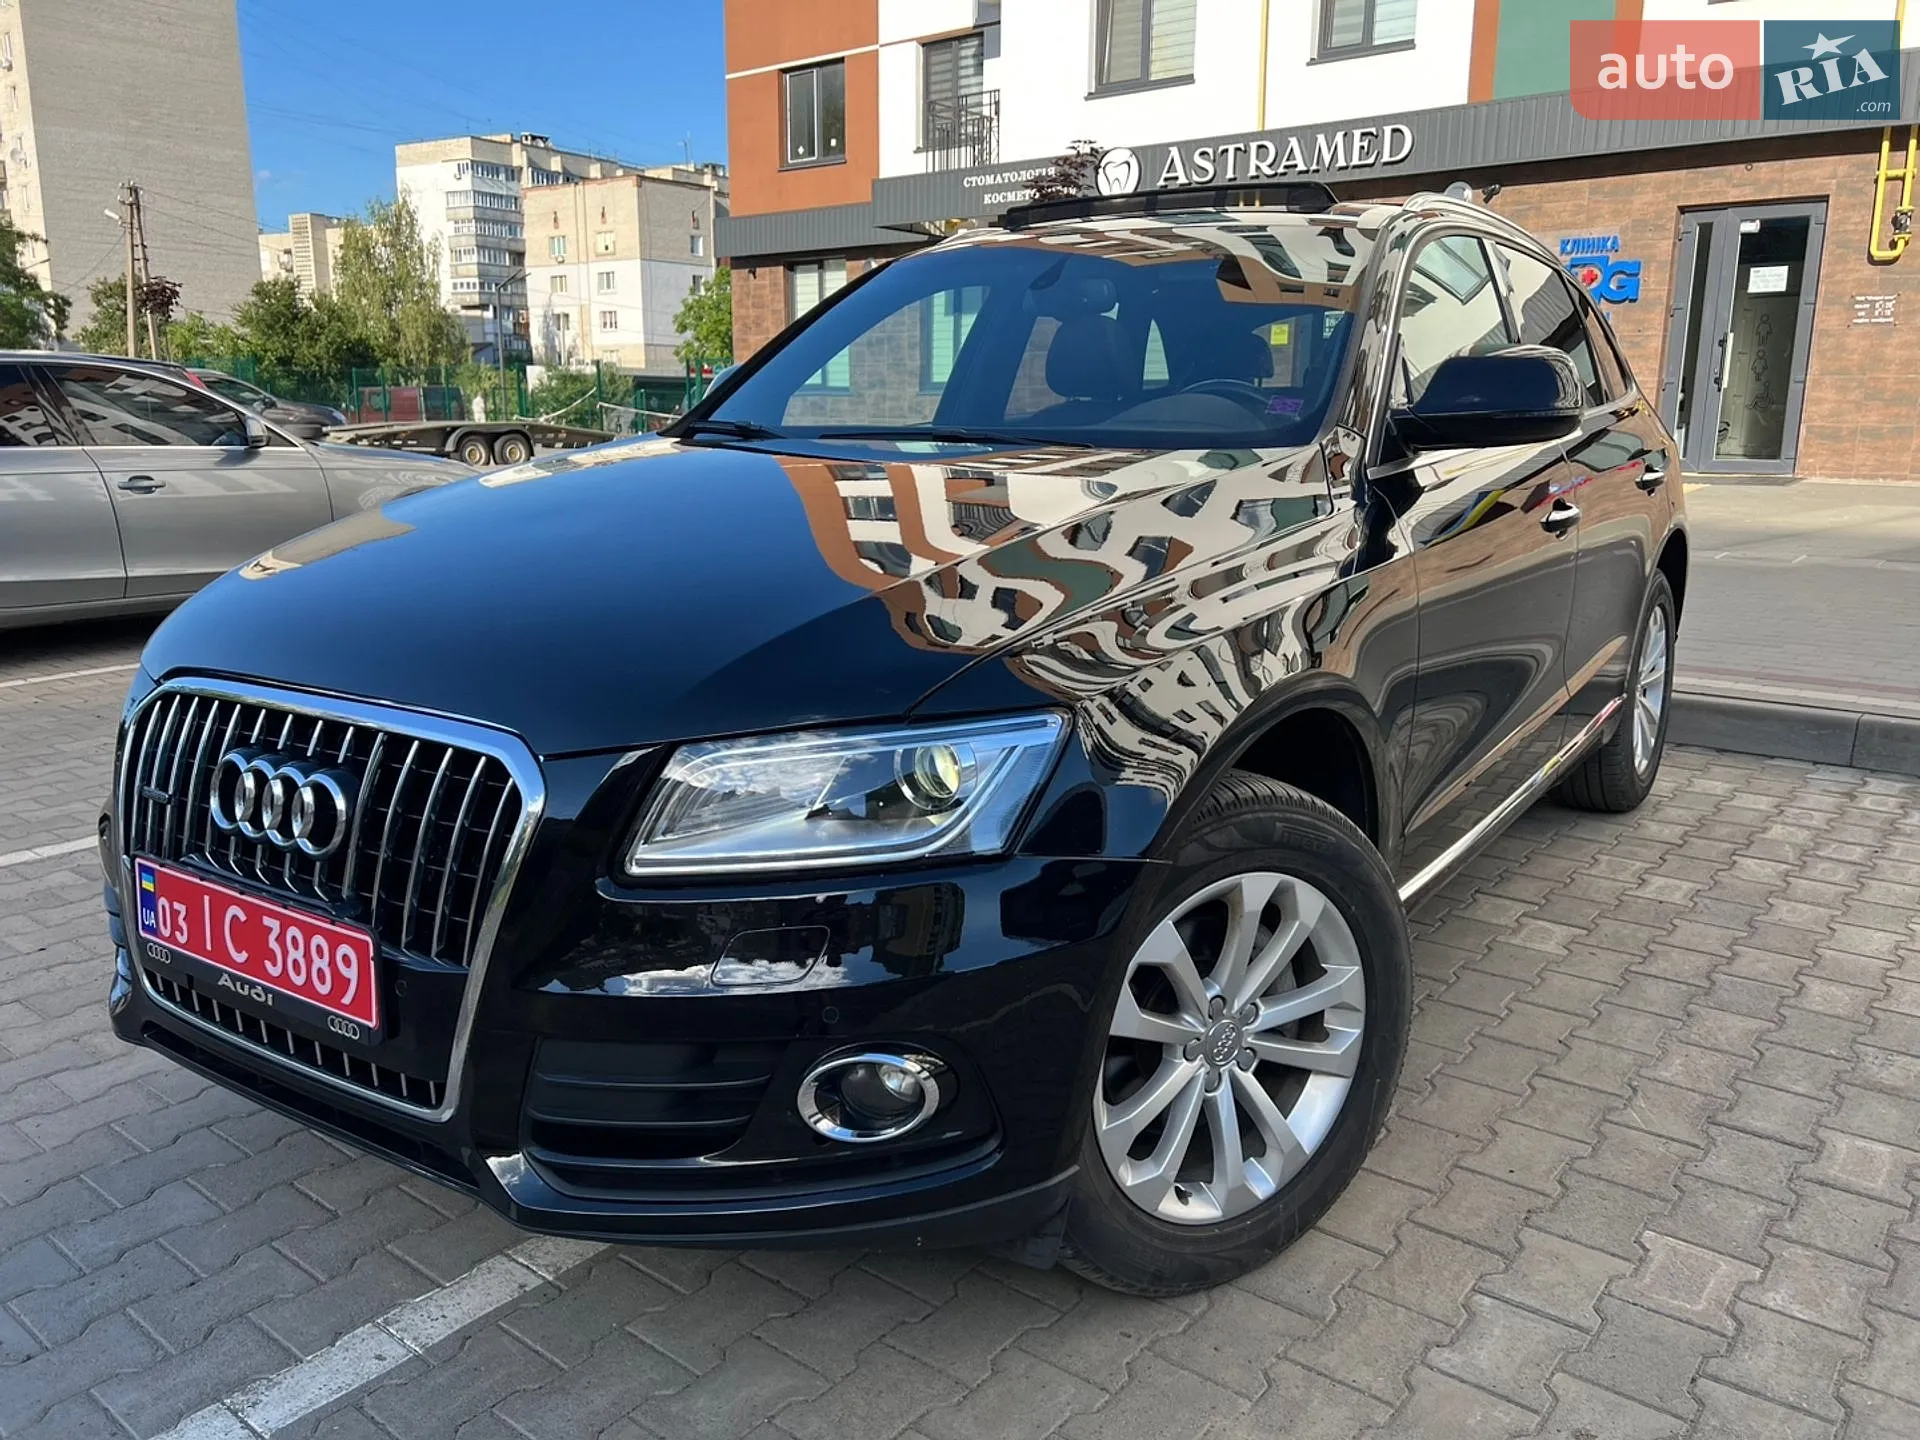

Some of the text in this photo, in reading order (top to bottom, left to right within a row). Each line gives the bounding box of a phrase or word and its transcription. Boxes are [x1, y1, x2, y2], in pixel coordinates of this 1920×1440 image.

[1157, 124, 1414, 187] ASTRAMED
[142, 907, 157, 929] UA
[157, 896, 188, 944] 03
[262, 915, 359, 1006] 3889
[218, 972, 274, 1007] Audi
